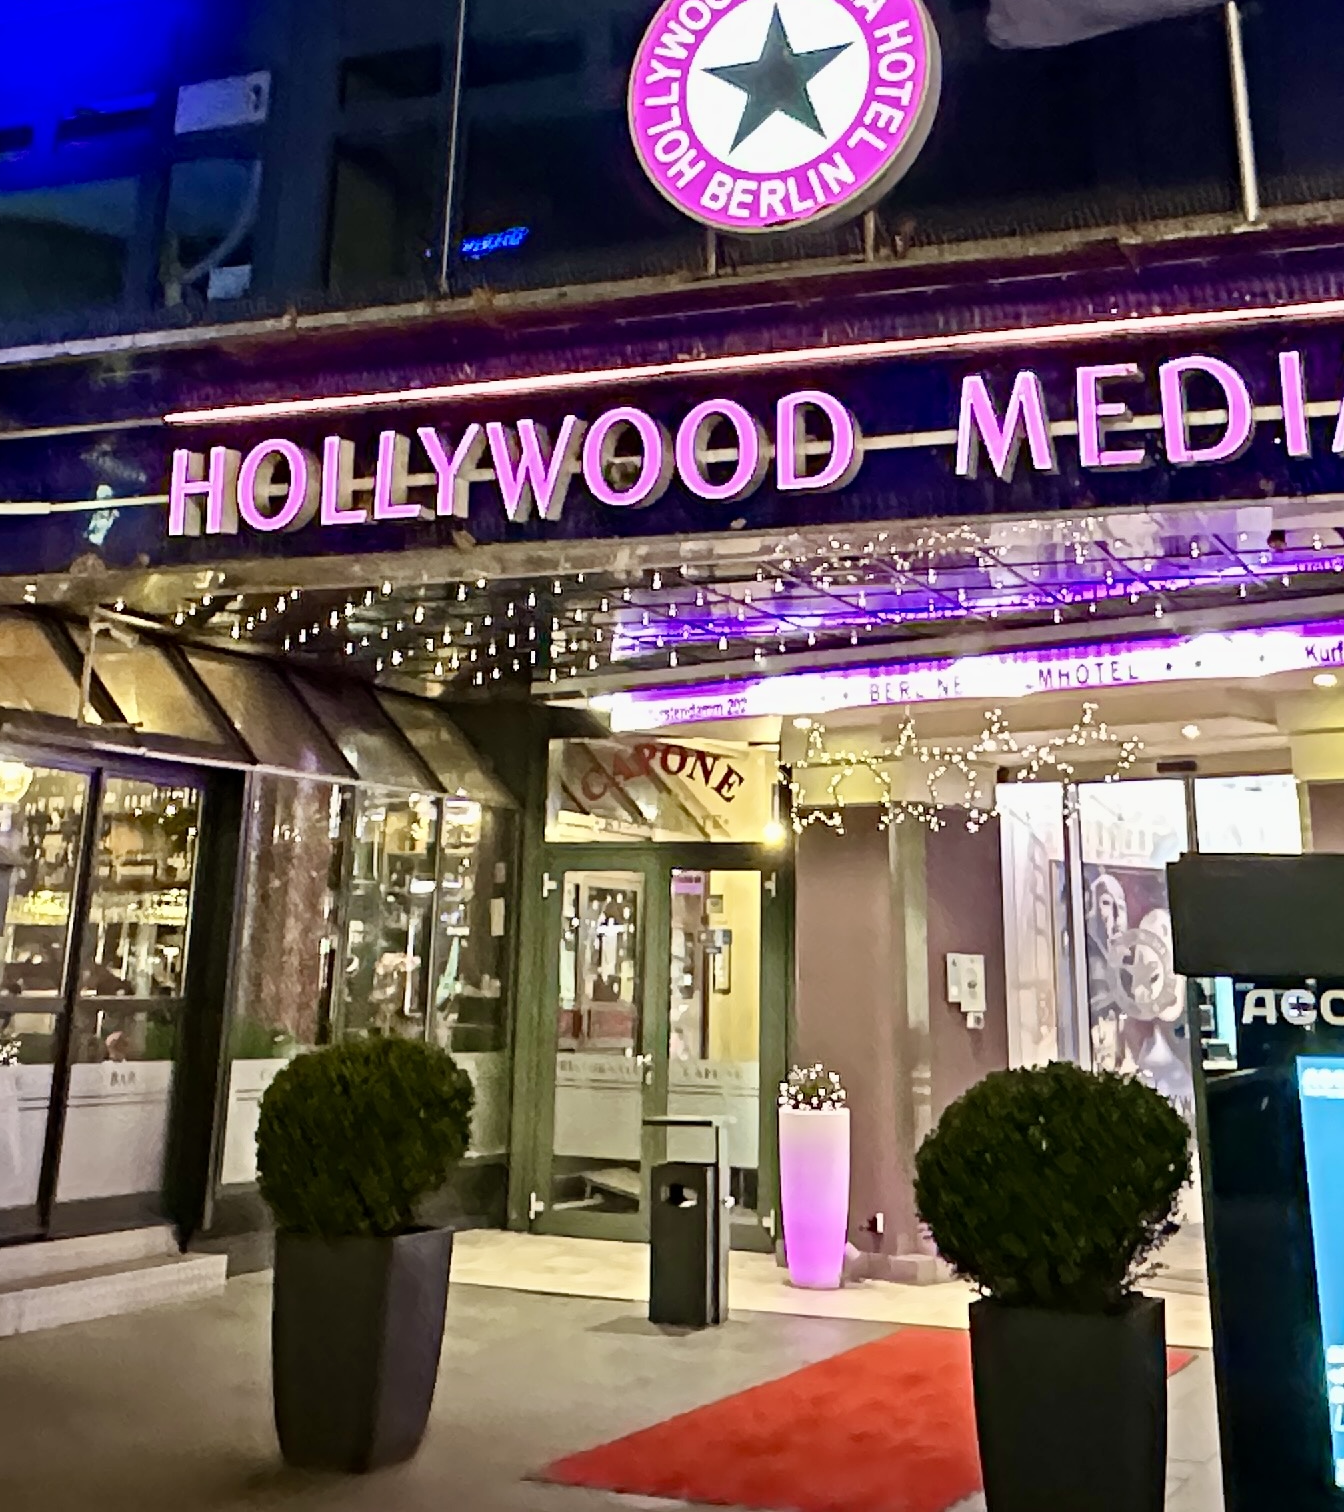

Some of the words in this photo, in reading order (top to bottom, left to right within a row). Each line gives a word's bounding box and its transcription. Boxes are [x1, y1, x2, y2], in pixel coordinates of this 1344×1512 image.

[847, 19, 916, 153] HOTEL
[700, 152, 857, 219] BERLIN
[168, 390, 854, 536] HOLLYWOOD
[869, 676, 962, 702] BERNE
[581, 744, 744, 803] CAPONE
